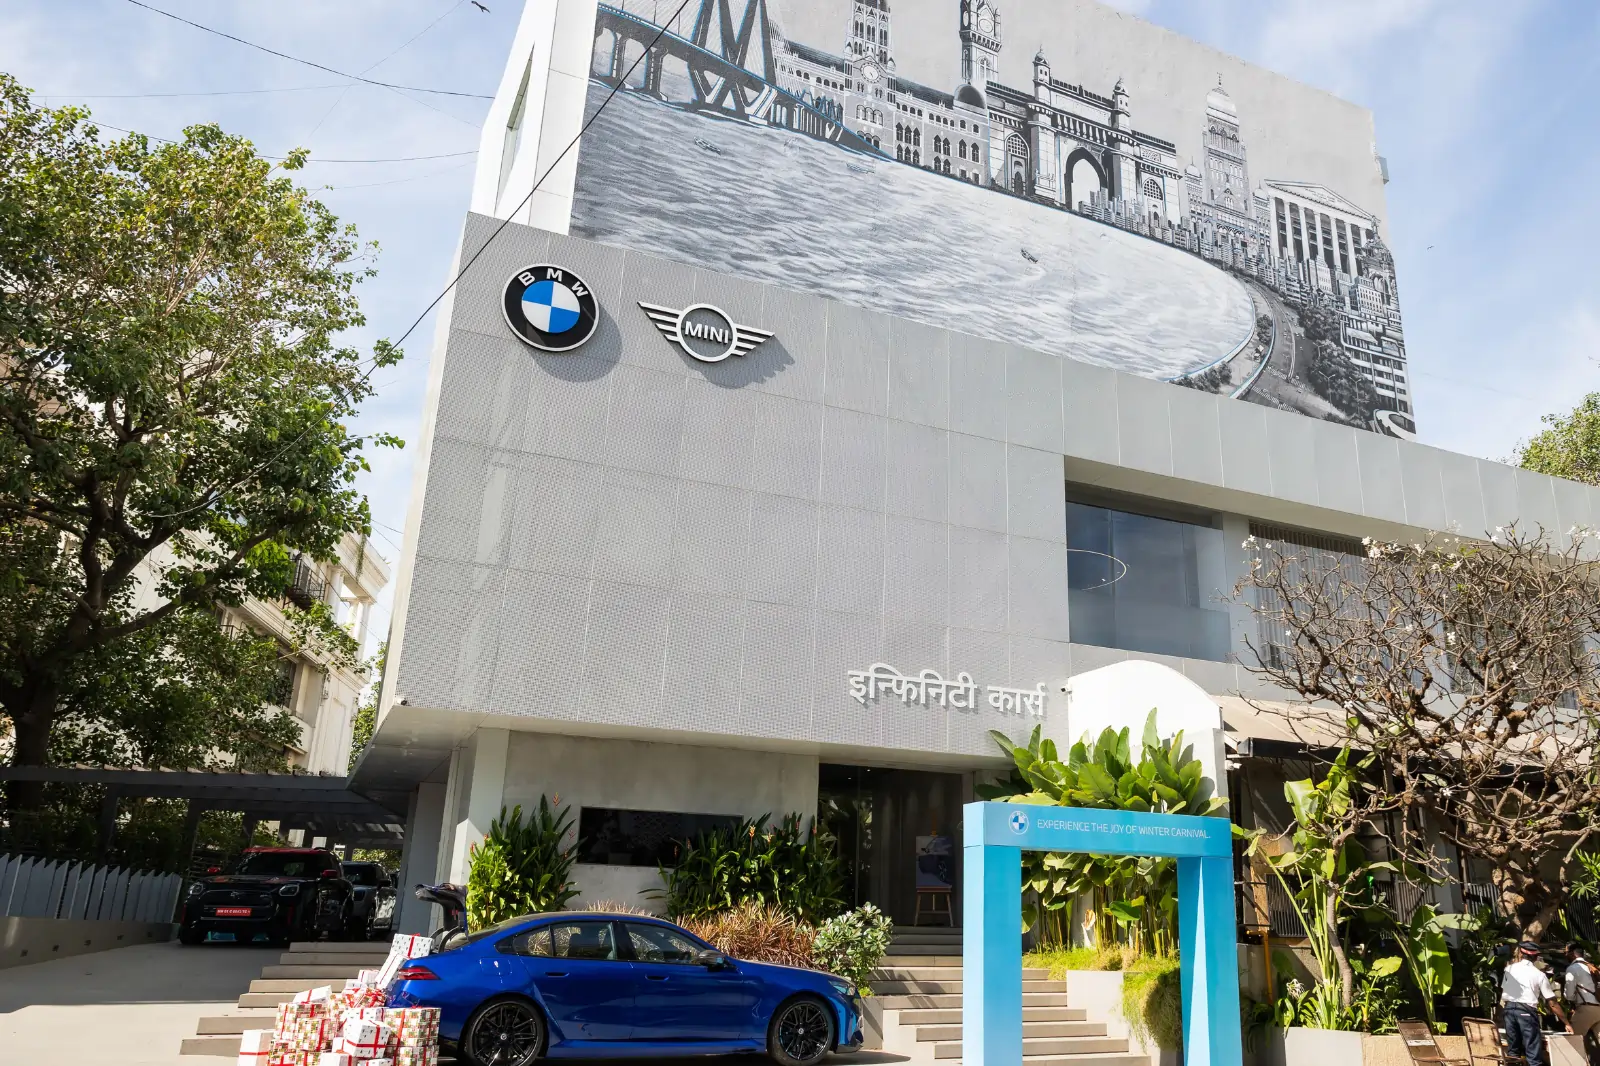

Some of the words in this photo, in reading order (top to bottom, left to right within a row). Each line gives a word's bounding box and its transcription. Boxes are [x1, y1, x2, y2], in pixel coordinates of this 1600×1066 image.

[518, 268, 588, 298] BMW
[685, 320, 730, 344] MINI
[848, 663, 978, 709] इन्फिनिटी
[987, 682, 1046, 716] कार्स
[1037, 818, 1090, 832] EXPERIENCE
[1091, 822, 1110, 833] THE
[1110, 824, 1124, 834] JOY
[1125, 824, 1137, 834] OF
[1139, 825, 1170, 836] WINTER
[1171, 827, 1211, 839] CARNIVAL.
